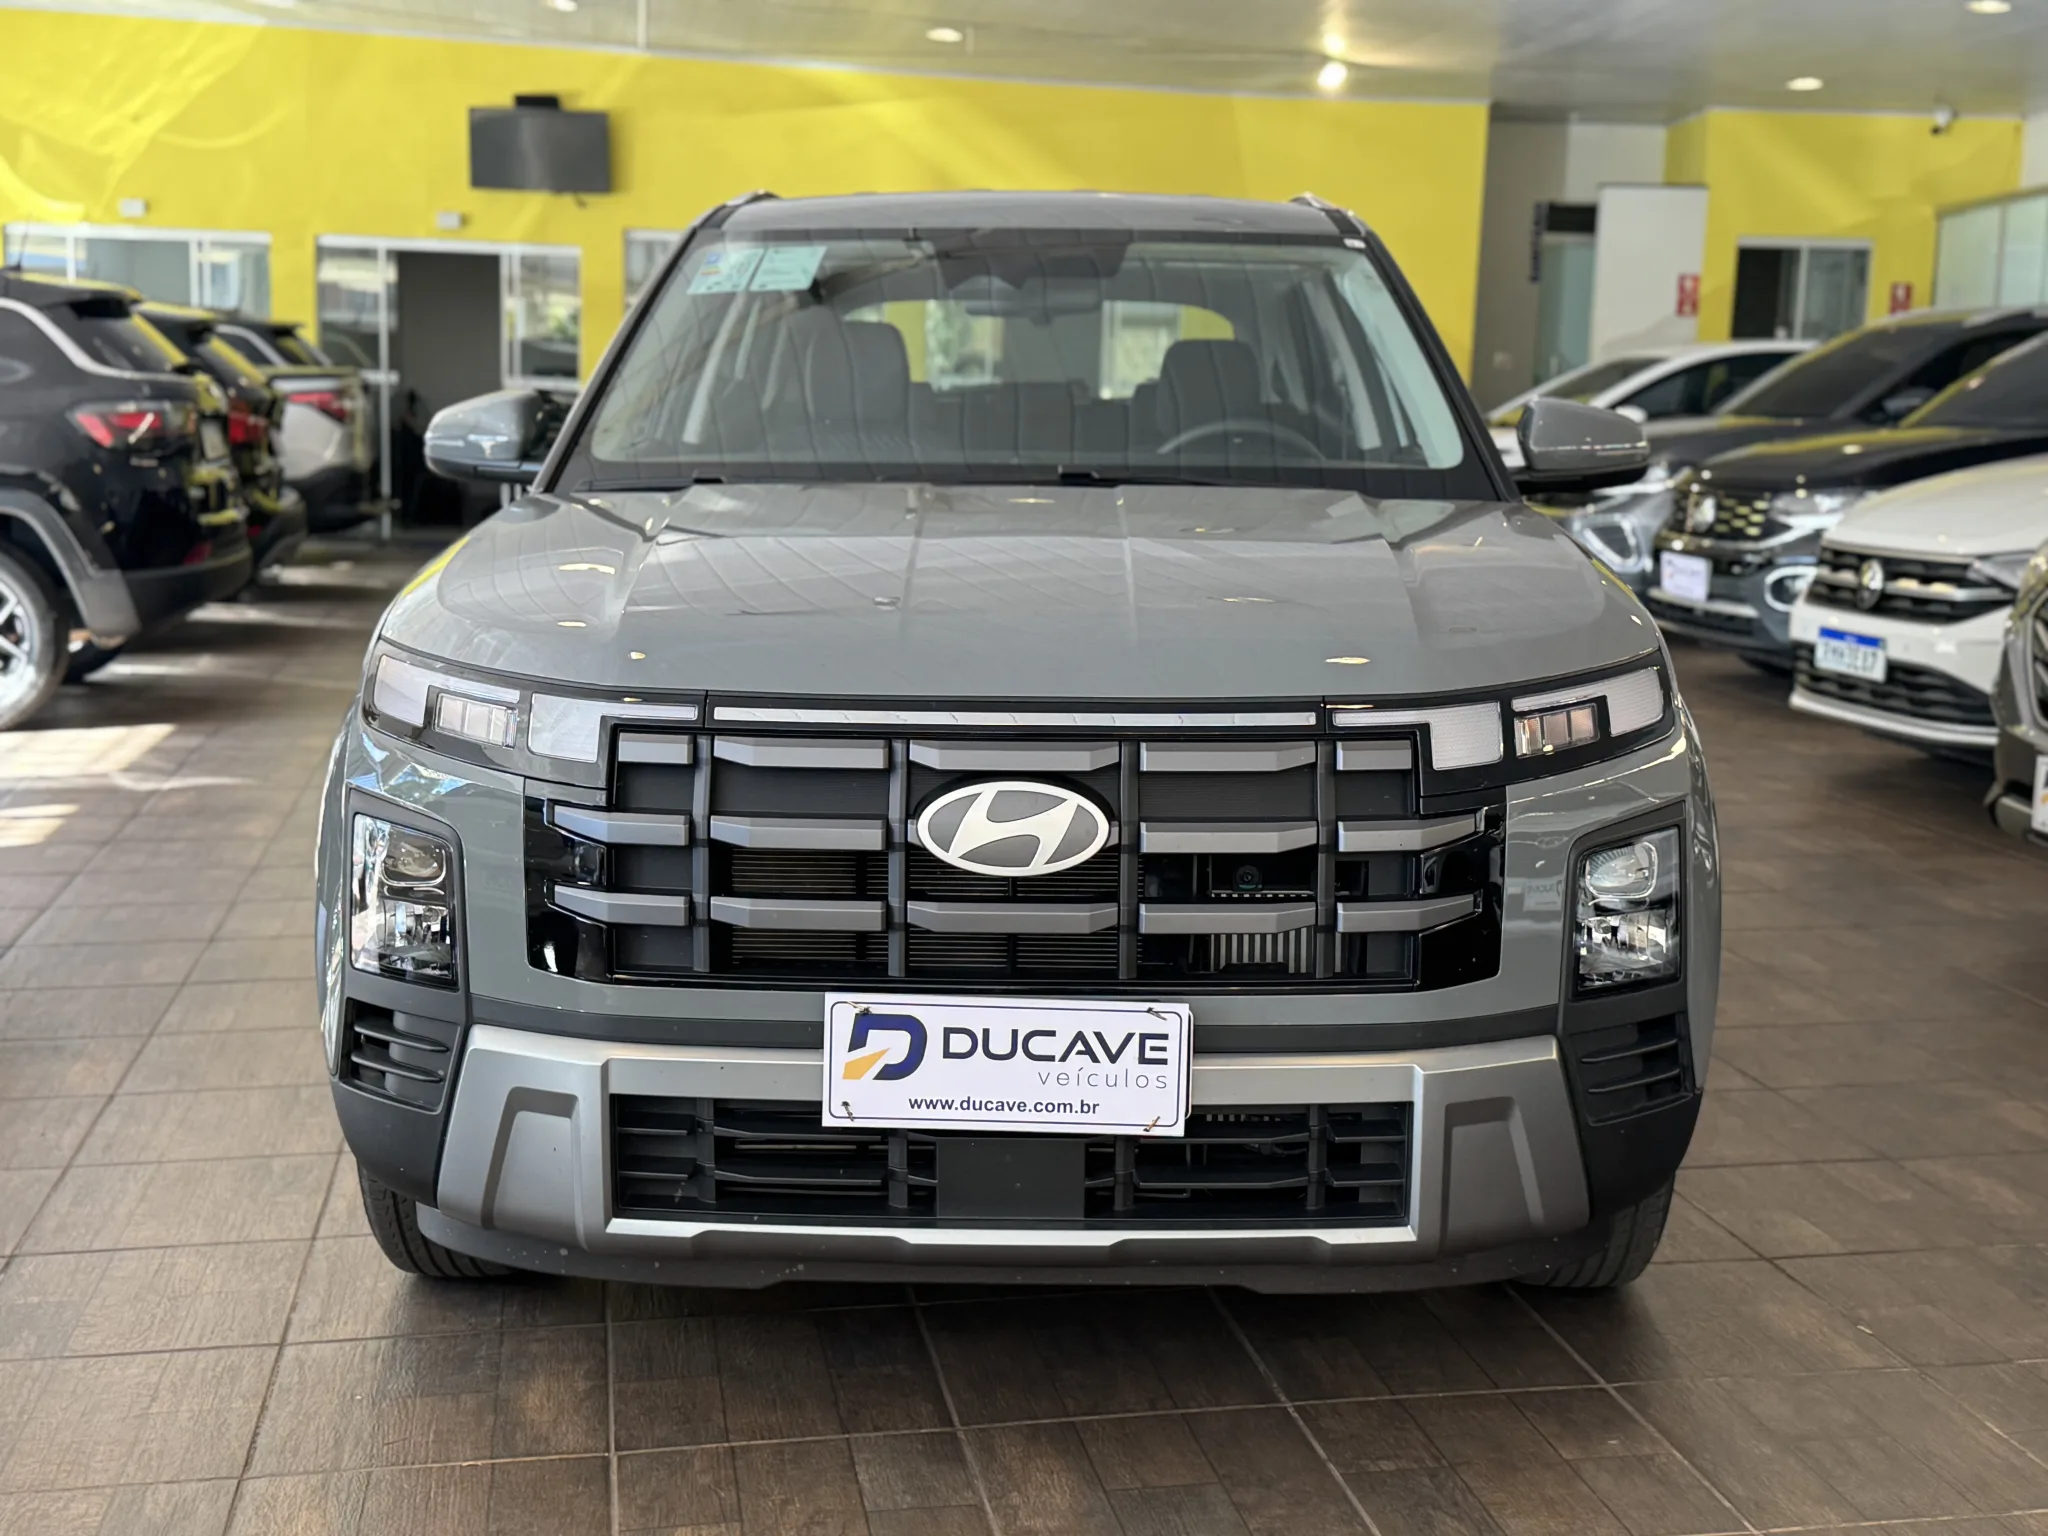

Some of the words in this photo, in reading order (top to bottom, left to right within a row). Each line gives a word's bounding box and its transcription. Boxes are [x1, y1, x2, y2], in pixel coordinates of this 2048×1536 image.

[942, 1026, 1170, 1066] DUCAVE
[1037, 1066, 1168, 1089] veículos
[908, 1095, 1100, 1115] www.ducave.com.br
